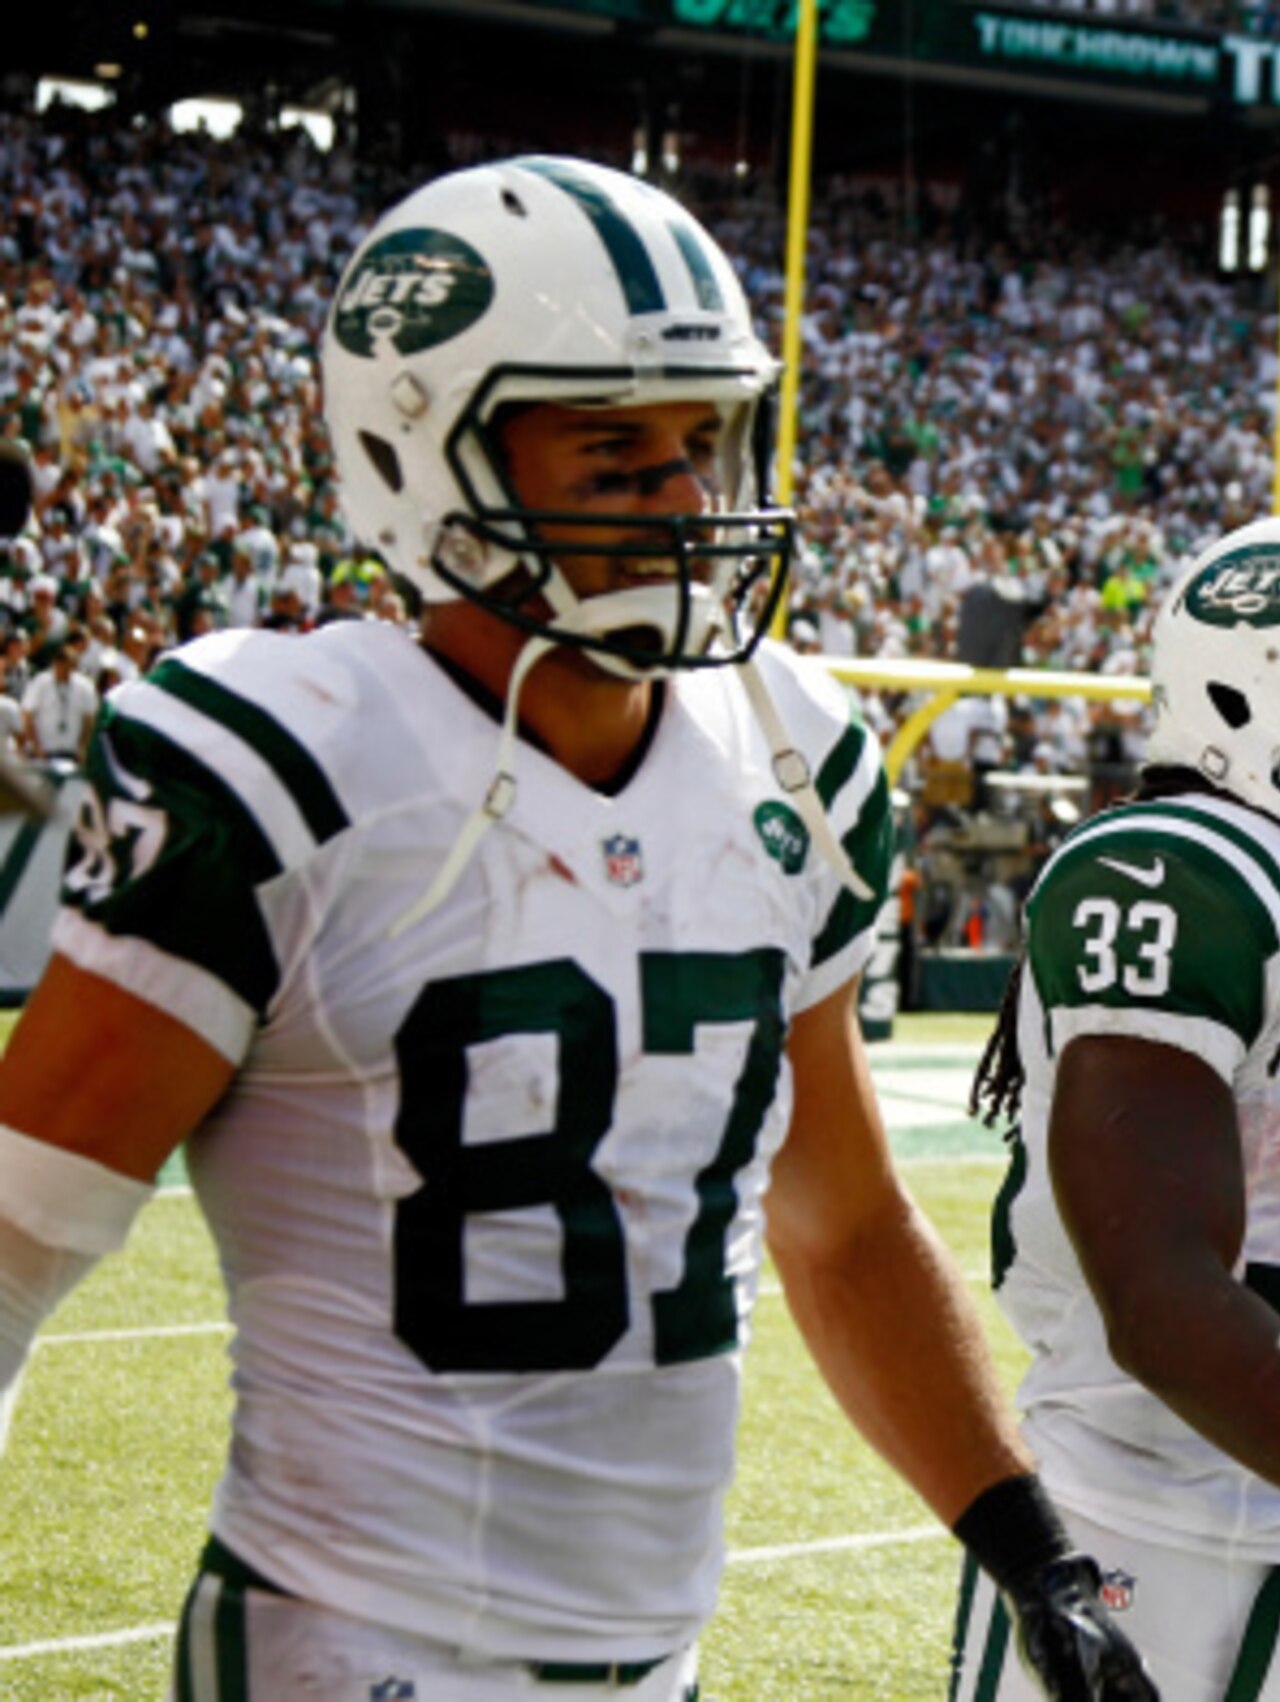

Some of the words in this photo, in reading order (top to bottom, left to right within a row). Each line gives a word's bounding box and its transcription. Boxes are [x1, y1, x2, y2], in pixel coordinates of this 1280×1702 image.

[973, 16, 1219, 79] TOUCHDOWN
[340, 267, 456, 313] JETS
[63, 778, 169, 902] 87
[1073, 897, 1178, 997] 33
[391, 946, 787, 1375] 87
